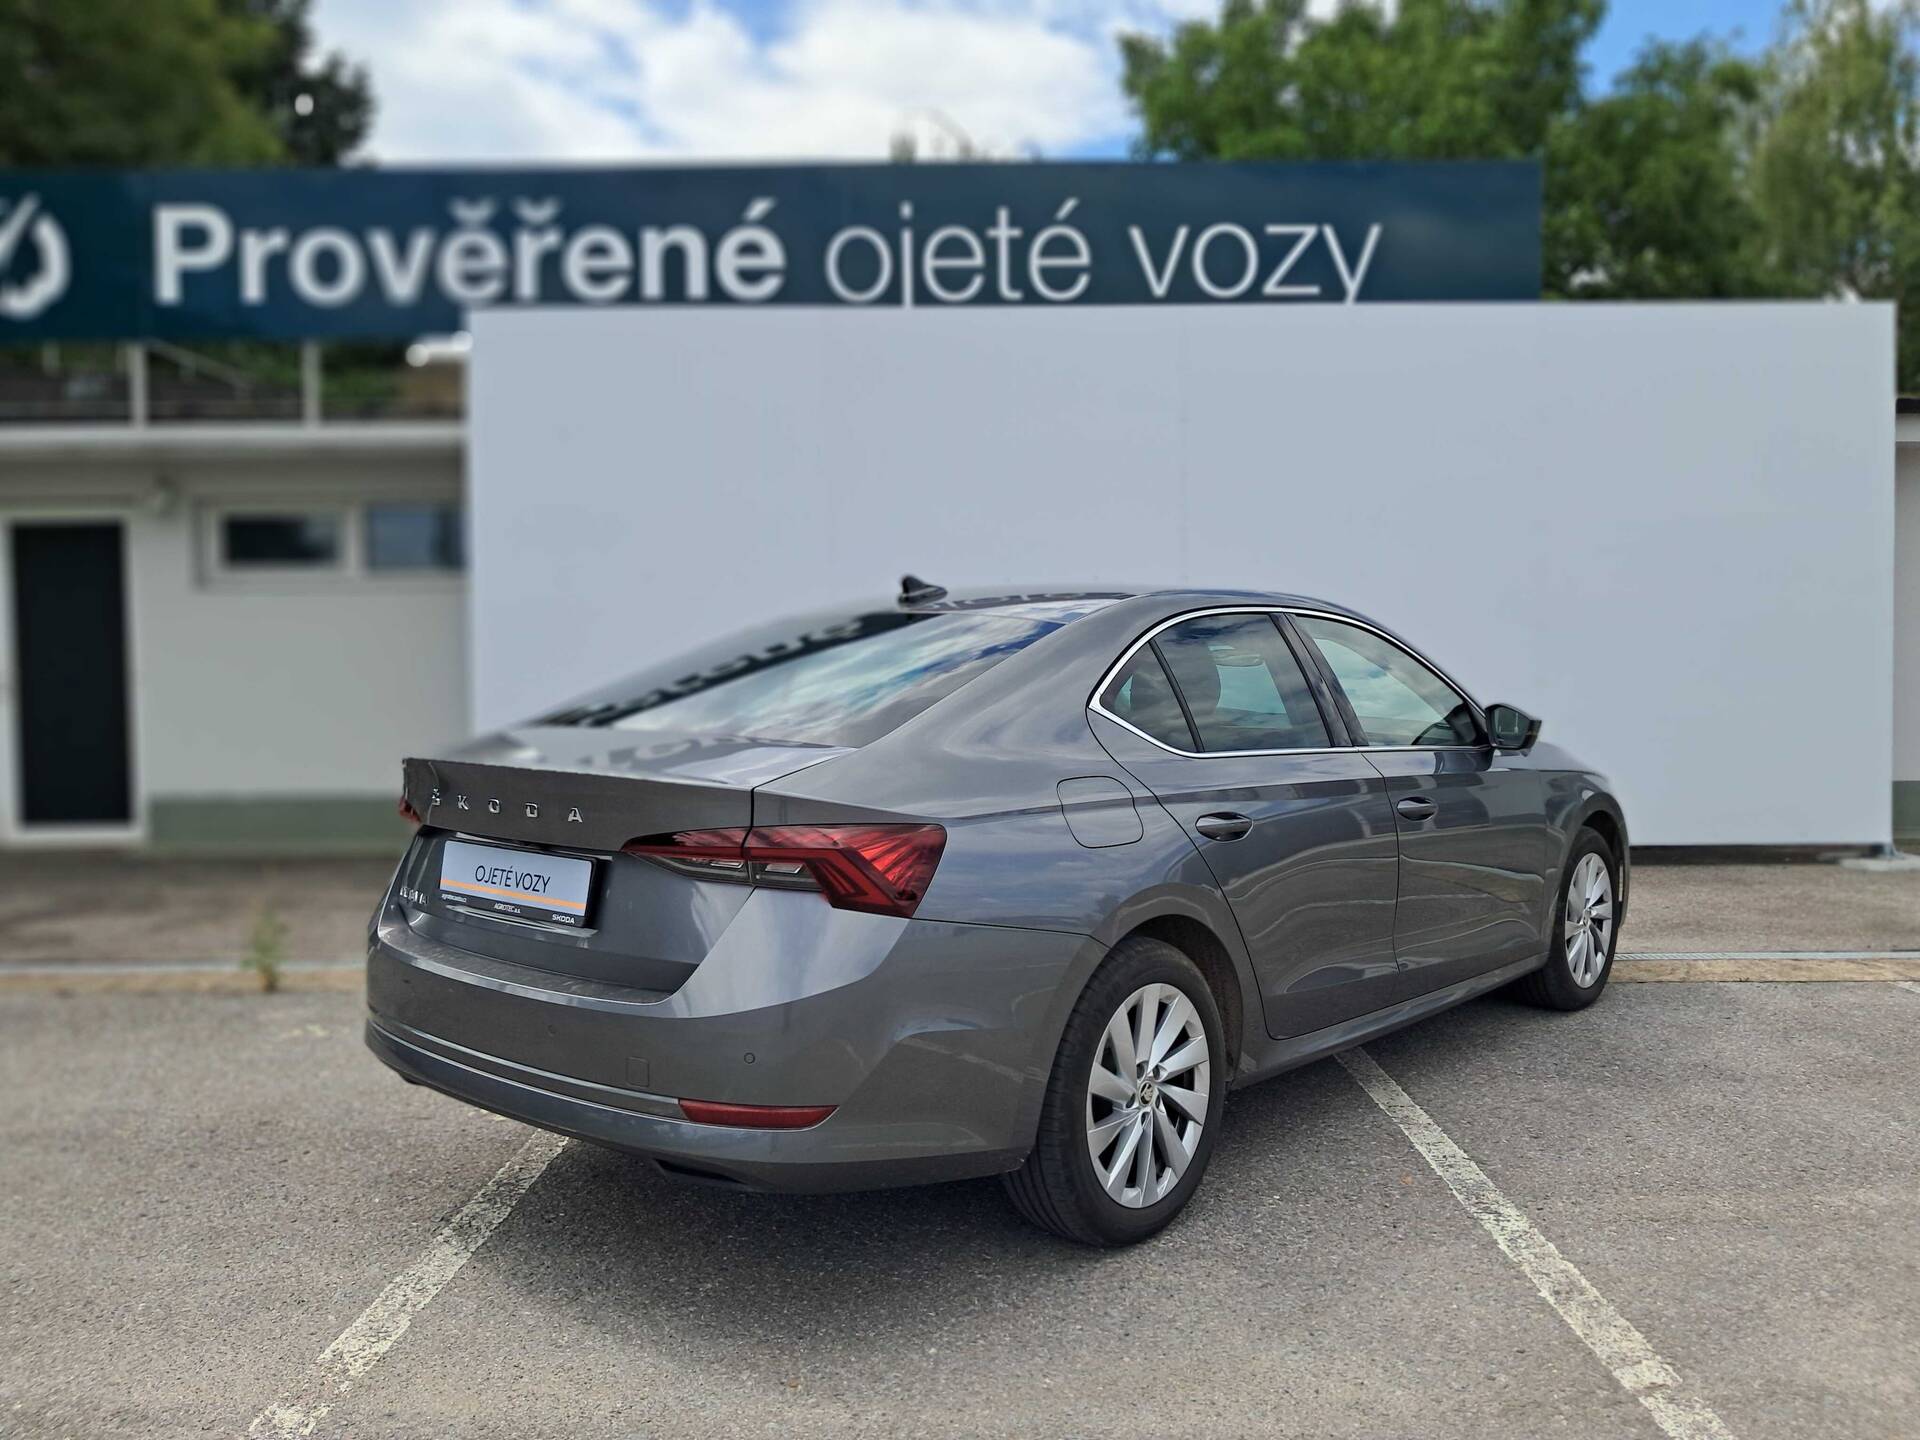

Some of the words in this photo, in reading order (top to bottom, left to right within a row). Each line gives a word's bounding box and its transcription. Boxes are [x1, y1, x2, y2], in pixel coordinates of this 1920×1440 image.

[152, 198, 787, 305] Prověřené
[825, 197, 1091, 306] ojeté
[1129, 222, 1382, 304] vozy
[475, 865, 513, 887] OJETÉ
[515, 871, 551, 893] VOZY
